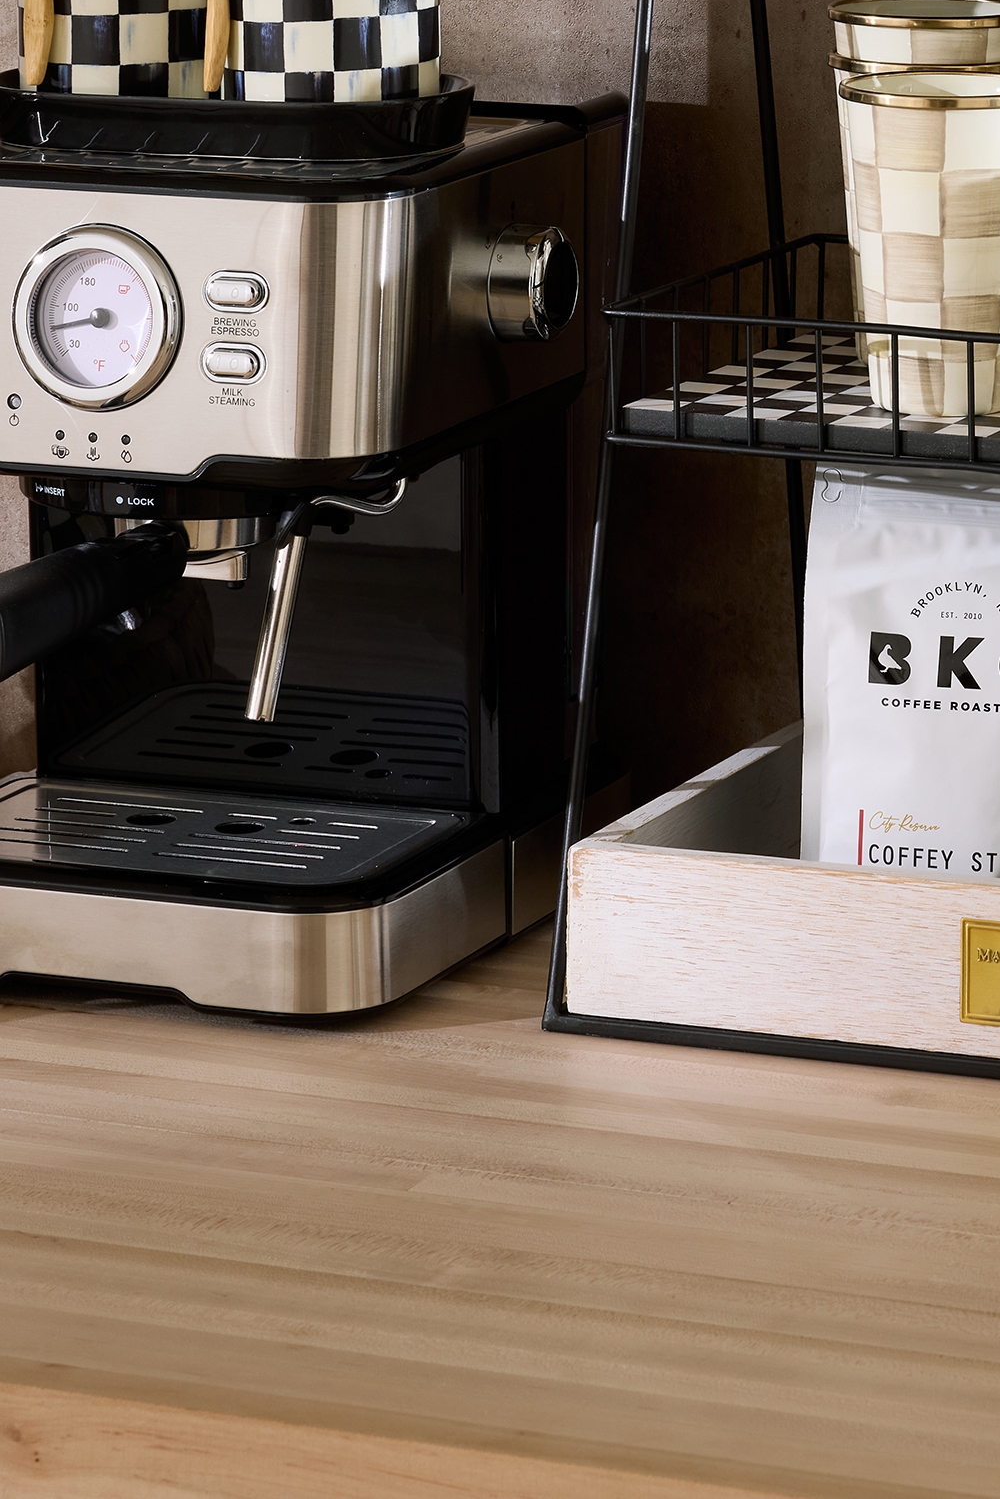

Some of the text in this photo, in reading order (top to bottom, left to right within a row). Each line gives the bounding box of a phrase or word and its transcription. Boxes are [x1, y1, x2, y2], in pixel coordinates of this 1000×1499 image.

[80, 276, 96, 287] 180
[63, 303, 79, 312] 100
[213, 317, 257, 328] BREWING
[210, 326, 260, 338] ESPRESSO
[69, 340, 81, 349] 30
[221, 387, 243, 397] MILK
[208, 396, 256, 407] STEAMING
[43, 486, 66, 497] INSERT
[127, 497, 155, 507] LOCK
[940, 610, 983, 621] EST. 2010
[881, 697, 942, 710] COFFEE
[898, 814, 941, 833] Reserve
[868, 843, 954, 871] COFFEY
